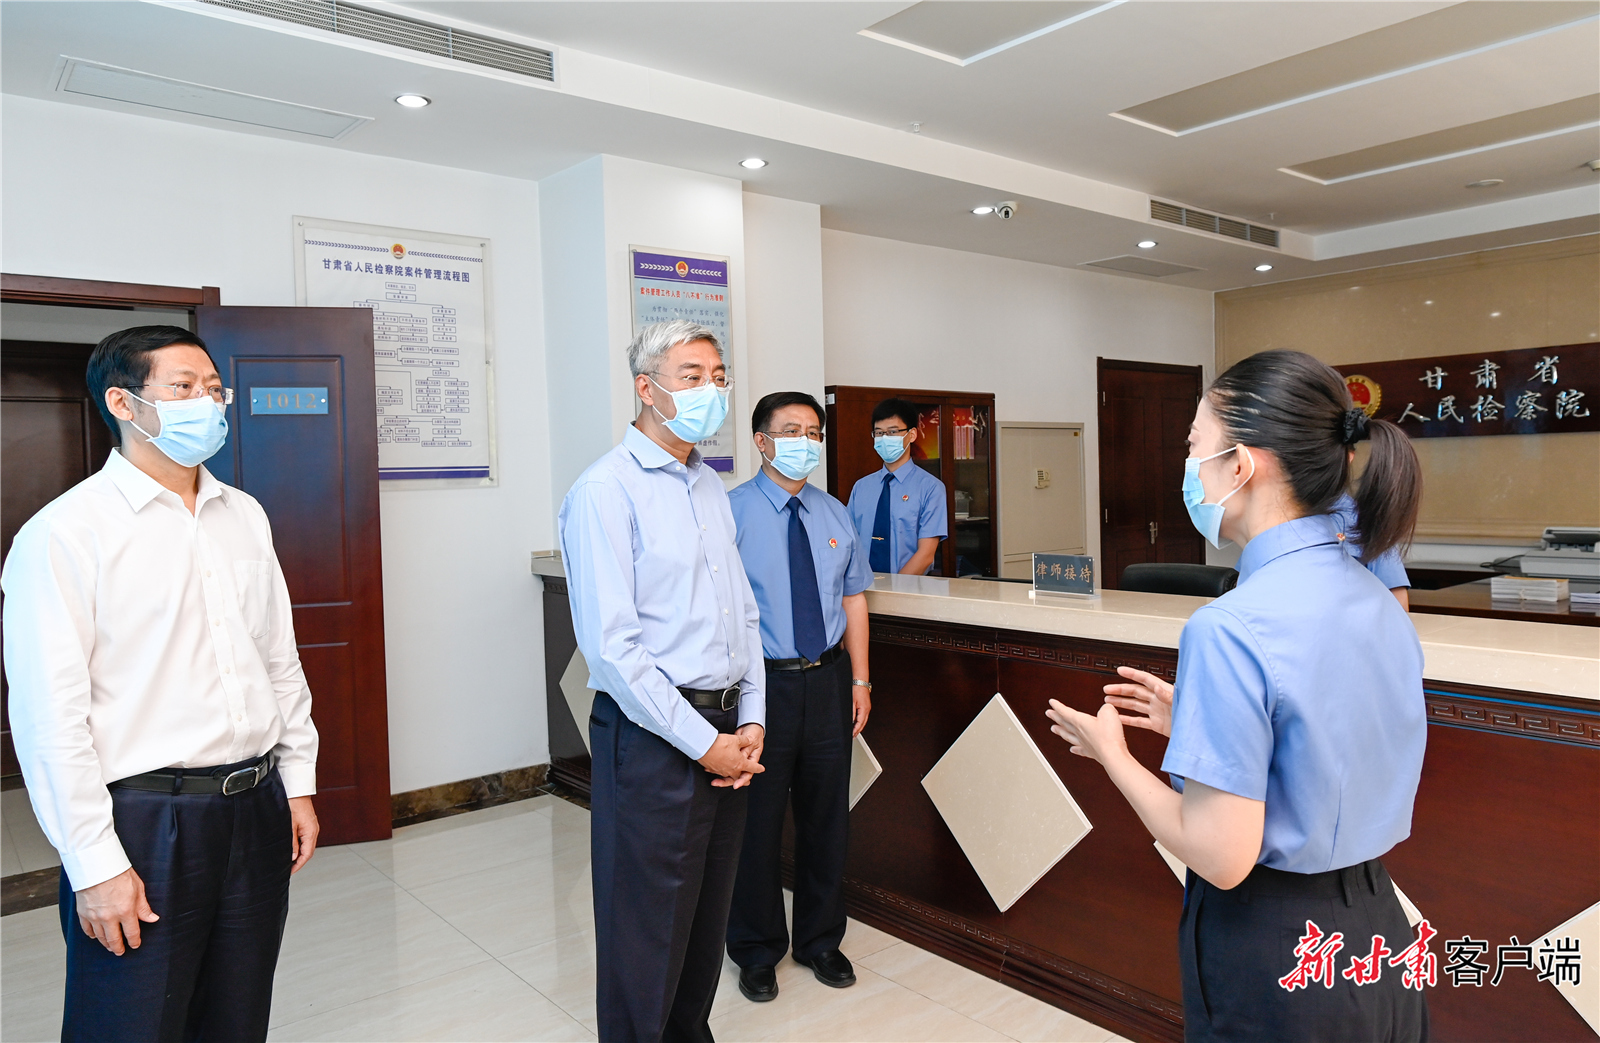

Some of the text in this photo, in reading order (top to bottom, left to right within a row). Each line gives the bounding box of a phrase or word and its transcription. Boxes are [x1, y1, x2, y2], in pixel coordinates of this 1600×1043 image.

[322, 258, 470, 283] 甘肃省人民检察院案件管理流程图
[1418, 355, 1560, 390] 甘肃省
[265, 393, 316, 409] 1012
[1397, 389, 1590, 424] 人民检察院
[1035, 561, 1092, 583] 律师接待
